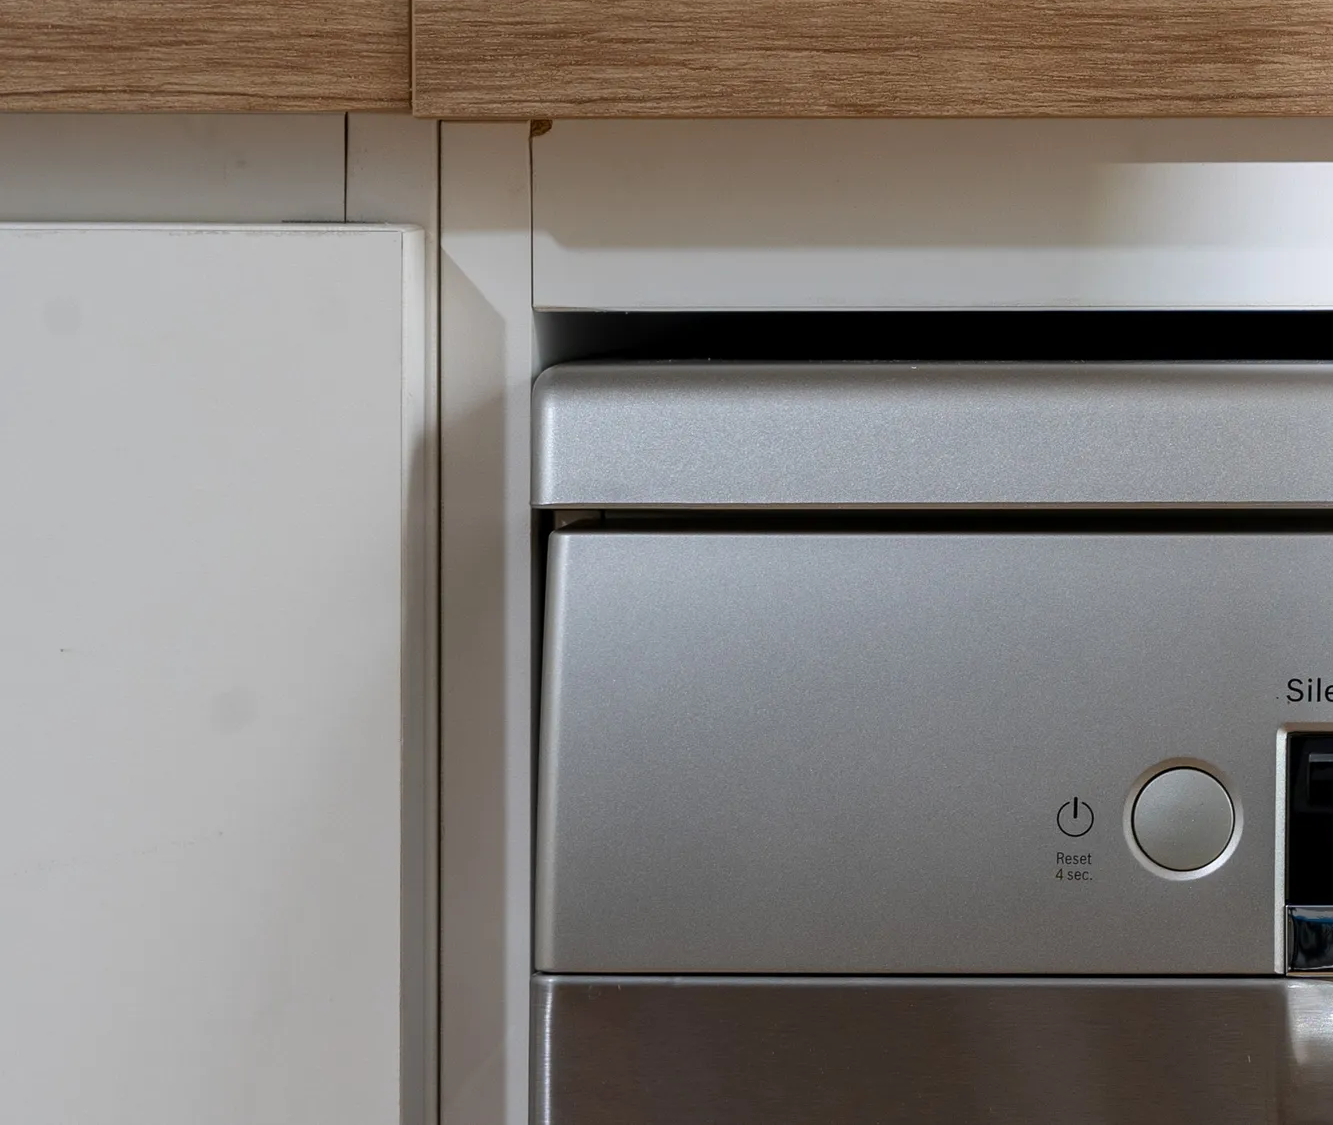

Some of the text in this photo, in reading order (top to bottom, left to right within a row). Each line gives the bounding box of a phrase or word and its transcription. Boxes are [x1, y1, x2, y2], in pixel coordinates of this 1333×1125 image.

[1056, 852, 1092, 865] Reset
[1055, 869, 1093, 881] 4 sec.
